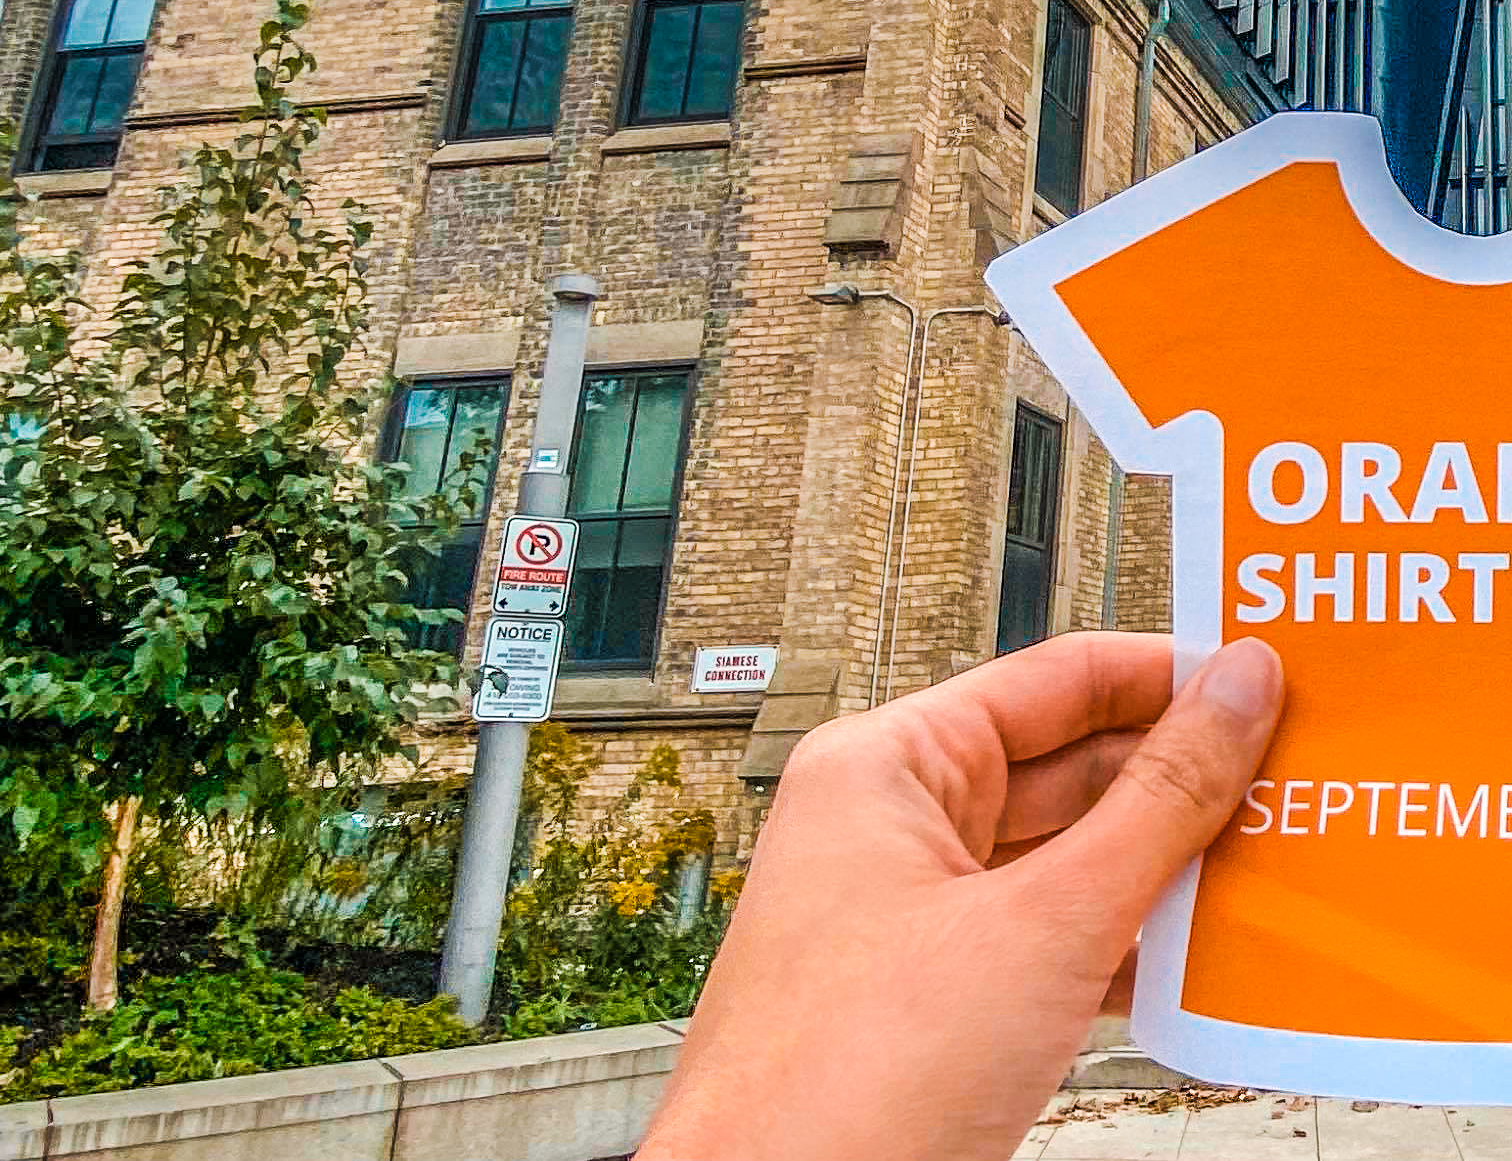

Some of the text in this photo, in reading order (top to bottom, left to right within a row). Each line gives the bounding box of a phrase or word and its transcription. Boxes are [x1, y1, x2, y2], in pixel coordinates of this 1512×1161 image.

[502, 569, 564, 582] FIRE ROUTE
[1236, 552, 1511, 624] SHIRT
[496, 625, 553, 640] NOTICE
[715, 655, 759, 667] SIAMESE
[704, 669, 766, 681] CONNECTION
